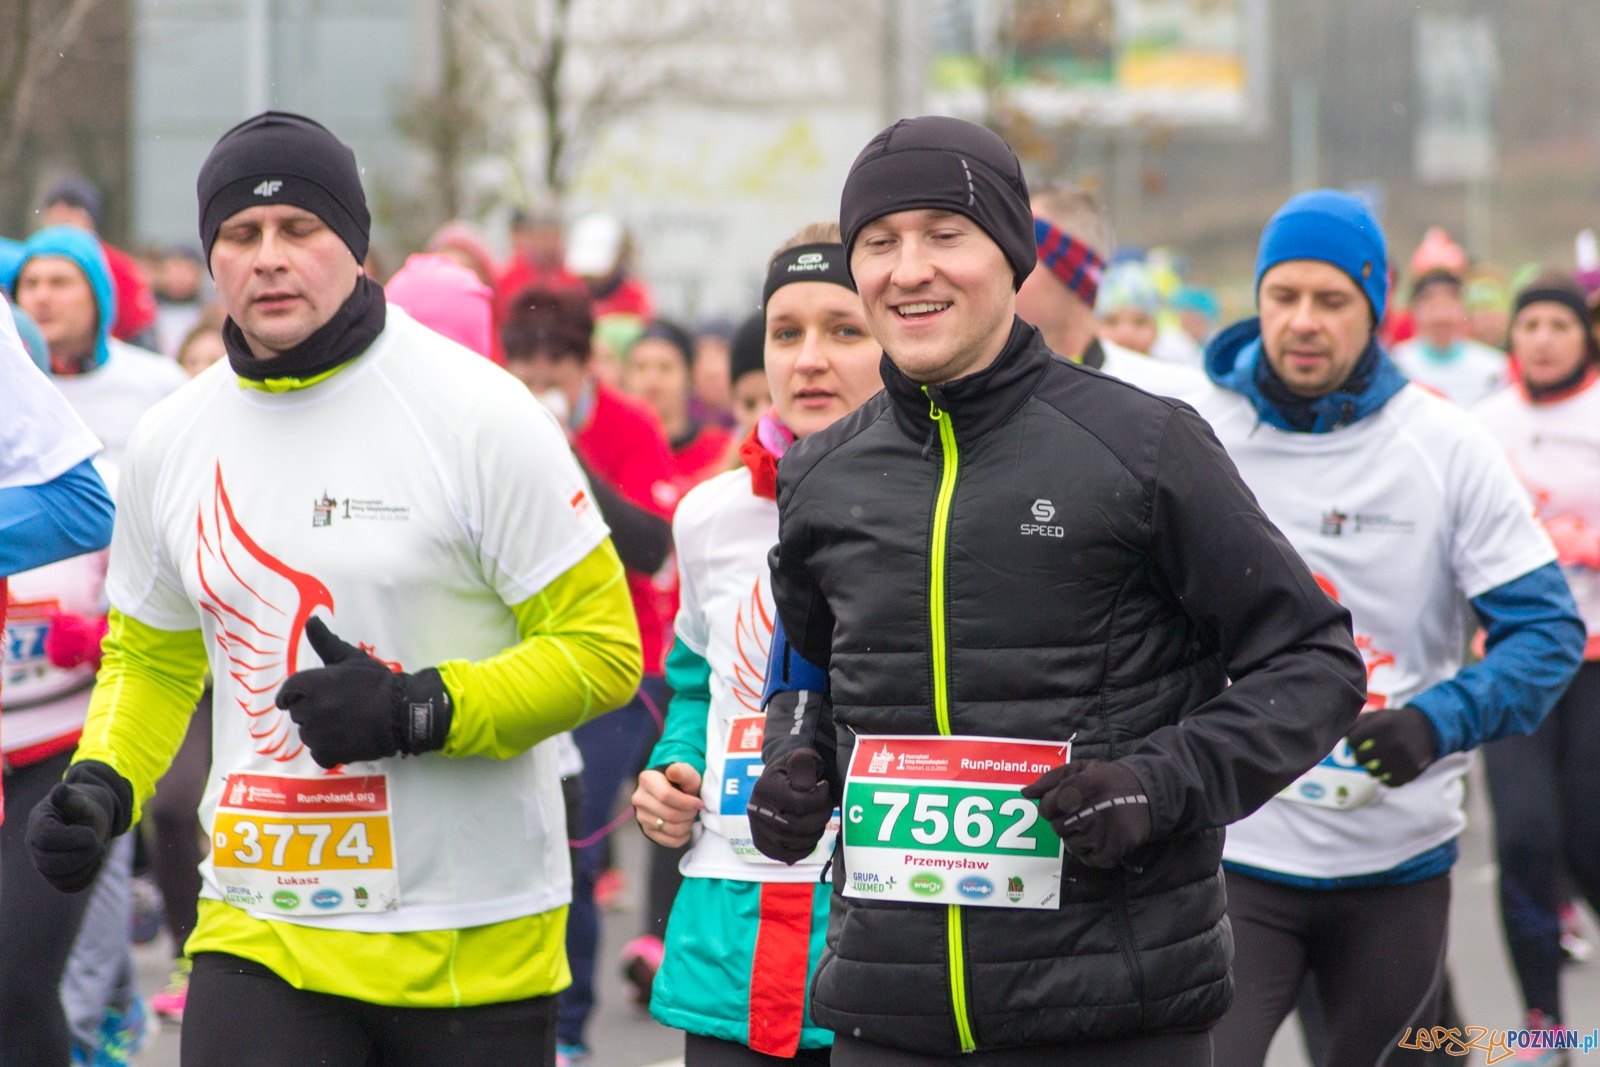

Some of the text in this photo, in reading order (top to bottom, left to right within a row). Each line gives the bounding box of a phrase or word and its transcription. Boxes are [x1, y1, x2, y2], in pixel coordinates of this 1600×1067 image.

[253, 180, 283, 197] 4F
[1020, 524, 1065, 538] SPEED
[896, 753, 905, 771] 1
[725, 778, 739, 794] E
[297, 792, 376, 804] RunPoland.org
[873, 791, 1039, 851] 7562
[215, 832, 228, 849] D
[233, 820, 374, 866] 3774
[904, 855, 989, 870] Przemysław
[277, 876, 320, 885] Łukasz
[853, 872, 879, 883] GRUPA
[853, 881, 884, 893] LUXMED
